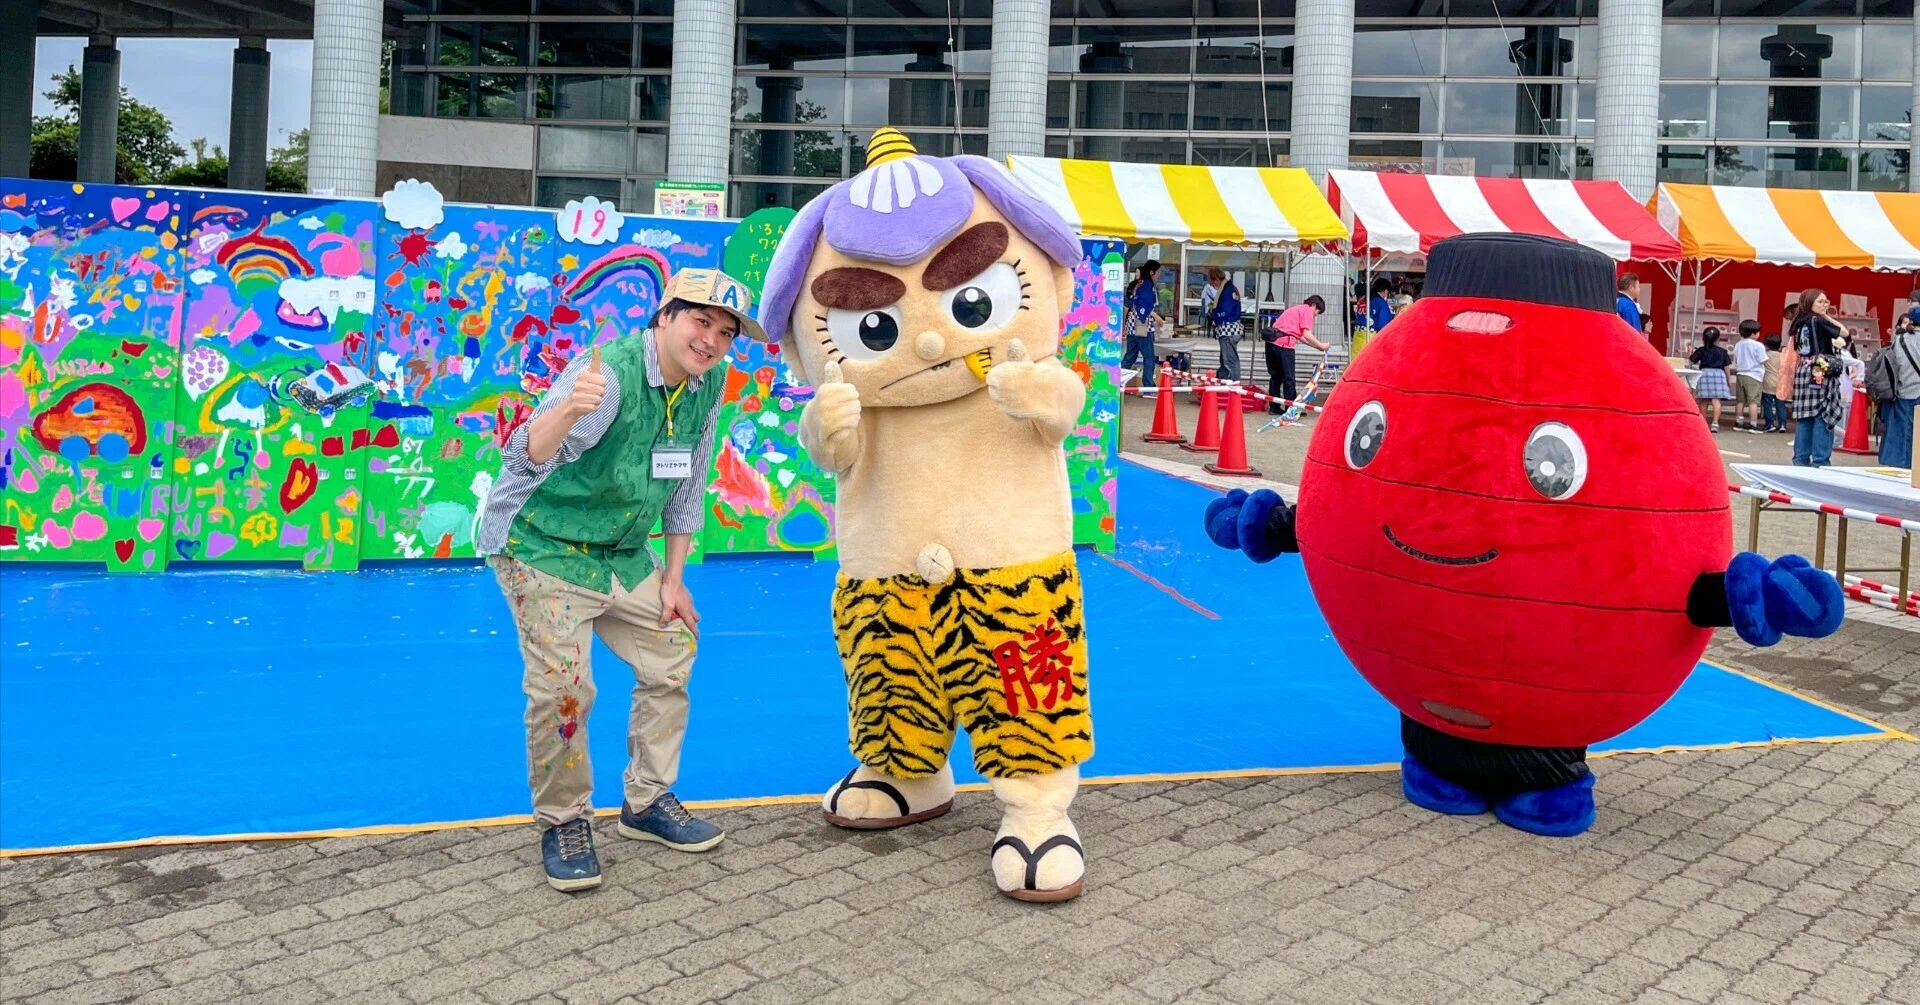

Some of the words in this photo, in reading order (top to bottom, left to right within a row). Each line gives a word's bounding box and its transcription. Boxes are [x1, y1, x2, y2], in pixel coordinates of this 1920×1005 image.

[573, 209, 606, 237] 19
[721, 284, 738, 309] A
[992, 617, 1074, 717] 勝
